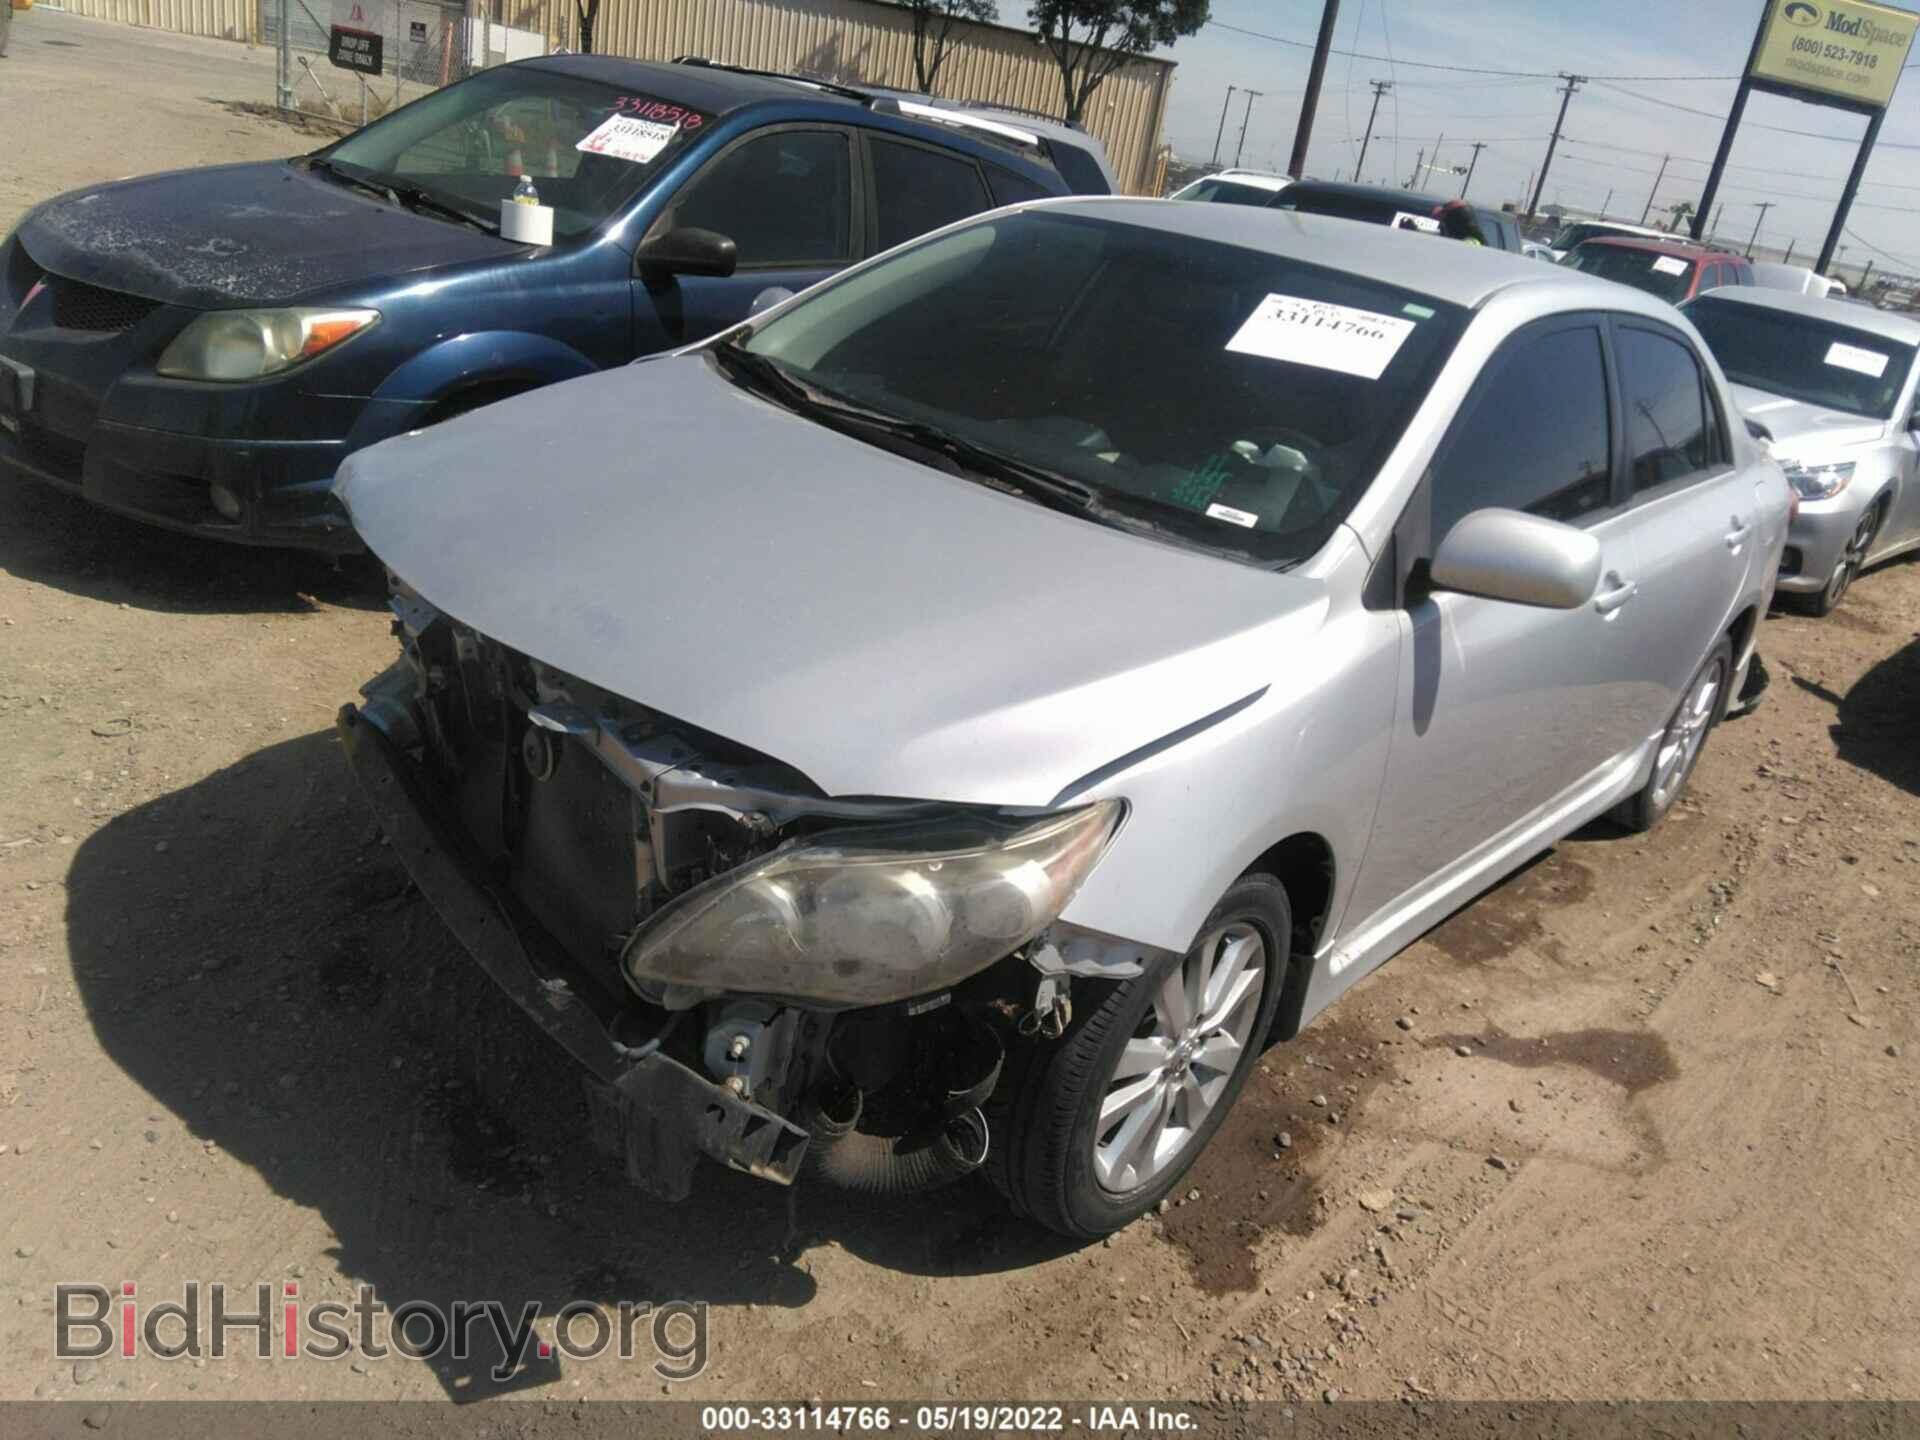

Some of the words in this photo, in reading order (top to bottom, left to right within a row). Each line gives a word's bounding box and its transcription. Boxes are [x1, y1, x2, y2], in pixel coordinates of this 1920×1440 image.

[1824, 10, 1907, 47] ModSpace
[1791, 35, 1823, 58] (800)
[1823, 45, 1879, 69] 523-7918
[1267, 308, 1385, 340] 33114766
